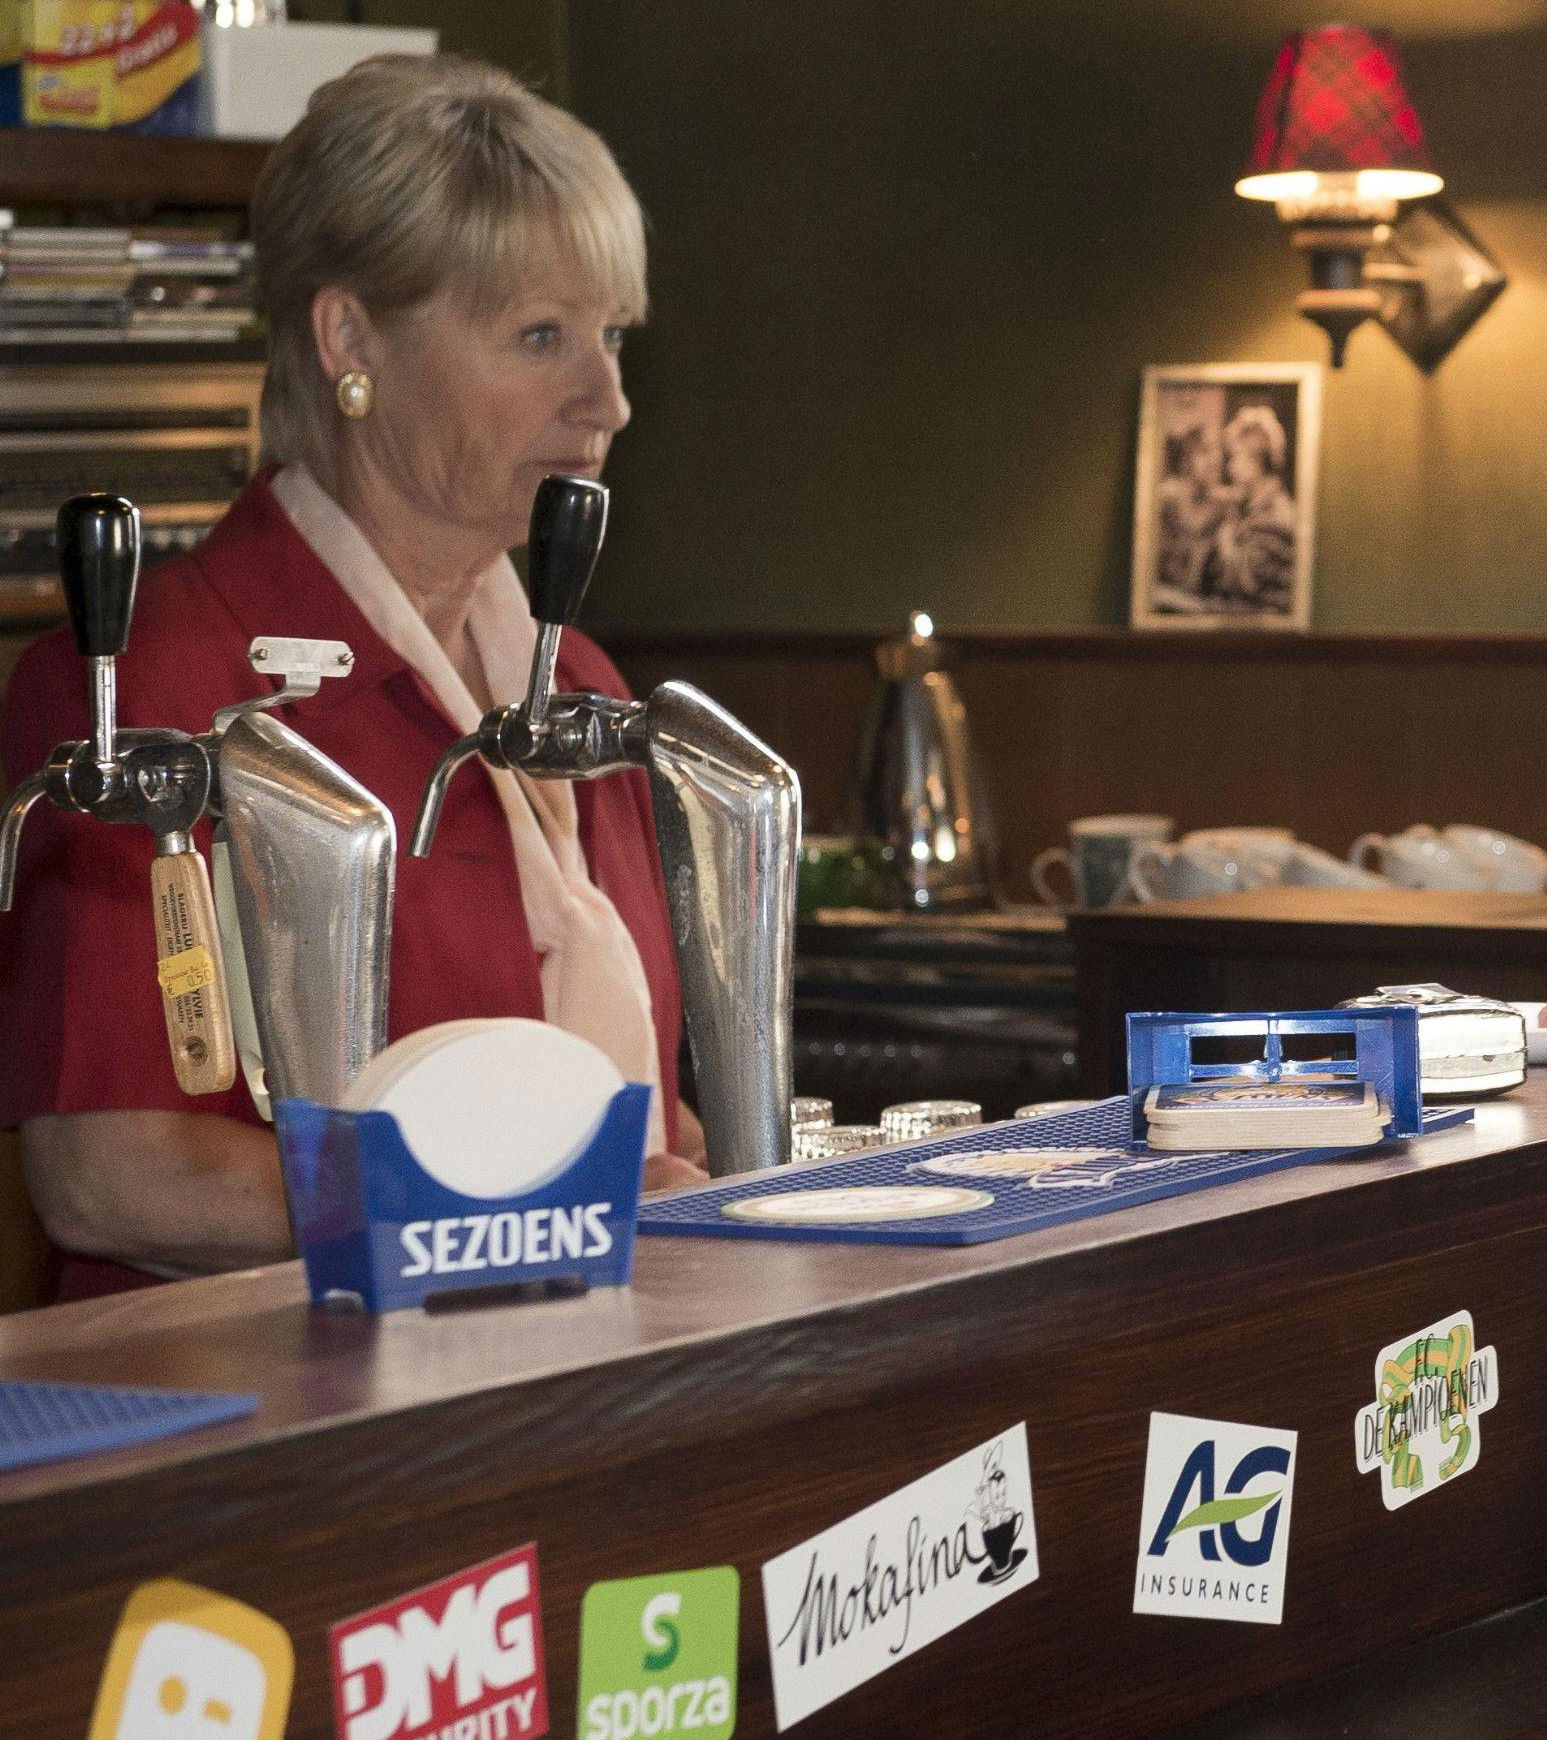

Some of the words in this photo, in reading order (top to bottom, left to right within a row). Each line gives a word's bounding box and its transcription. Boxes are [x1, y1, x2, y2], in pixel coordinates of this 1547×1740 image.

[400, 1202, 613, 1278] SEZOENS
[1363, 1404, 1386, 1462] DE
[1388, 1354, 1489, 1452] KAMPIOENEN
[1147, 1440, 1291, 1567] AG
[778, 1515, 987, 1666] Mokafina
[1140, 1575, 1269, 1604] INSURANCE
[341, 1560, 535, 1740] DMG
[585, 1675, 731, 1740] sporza
